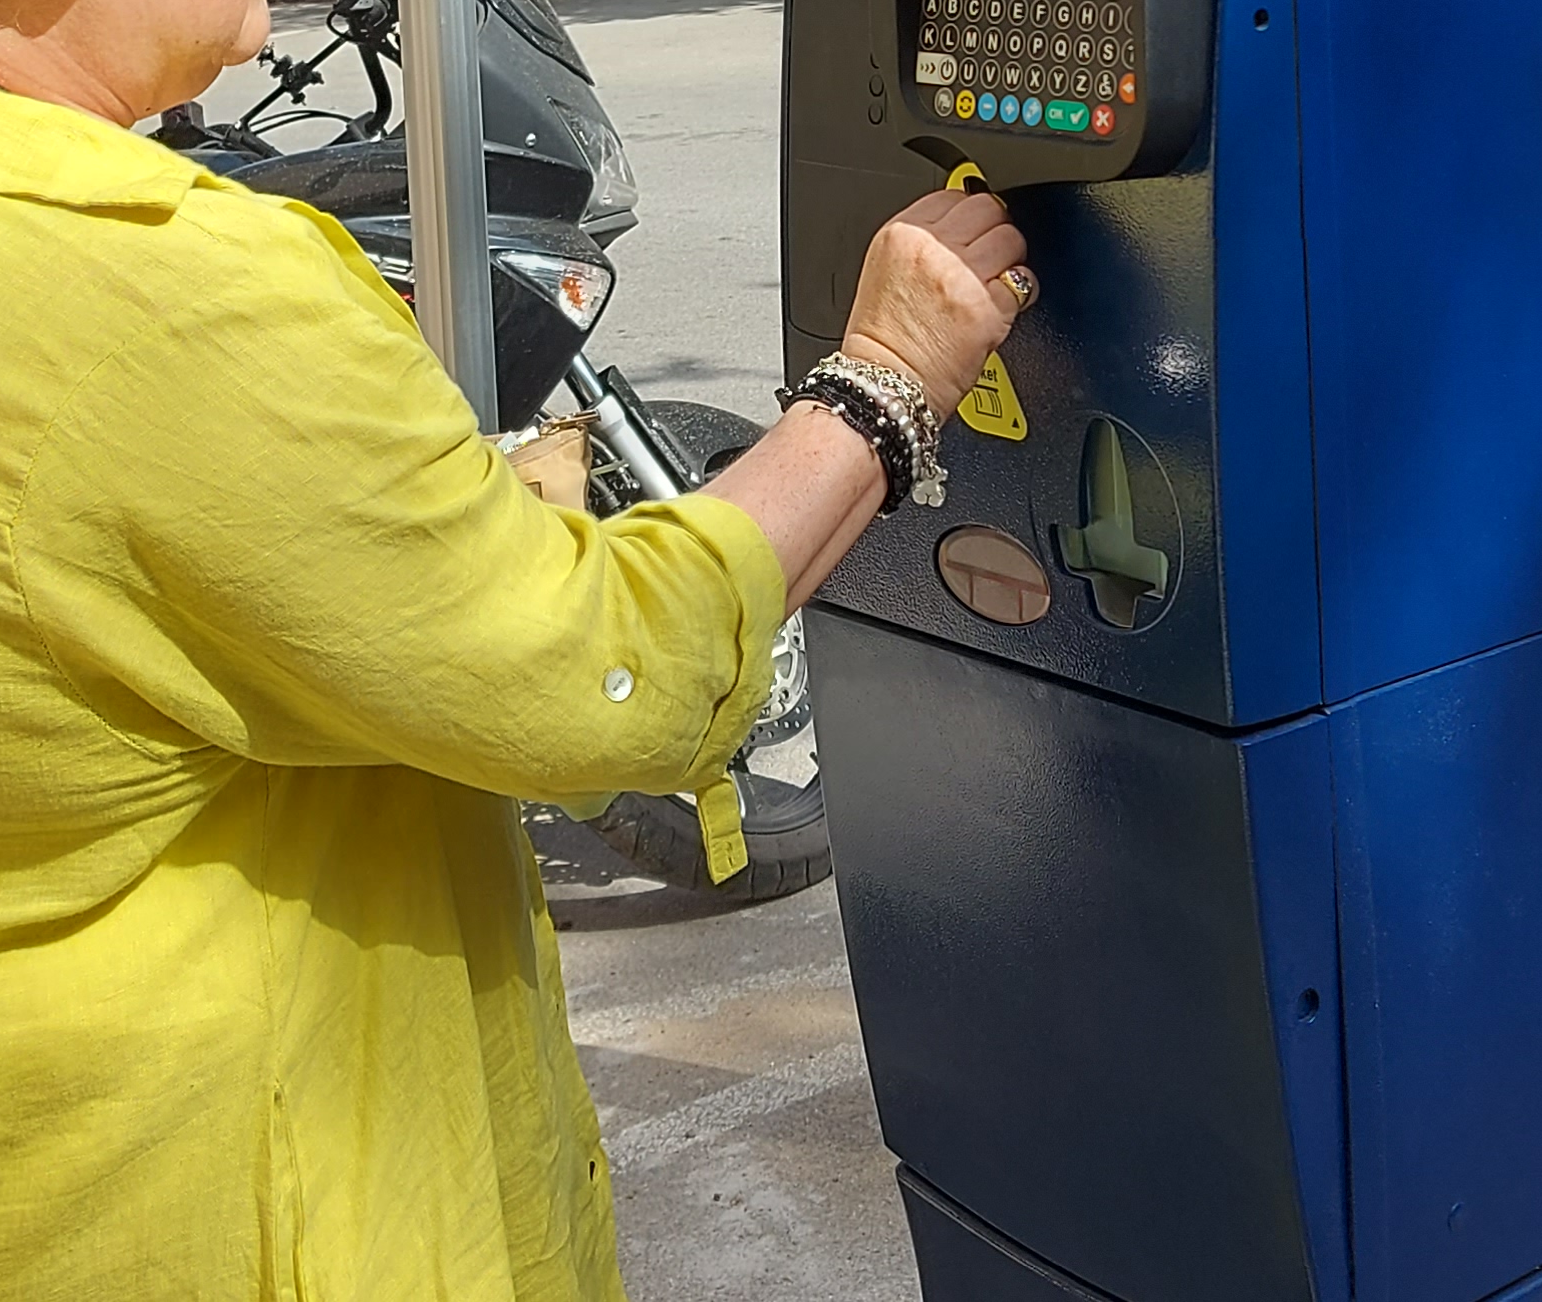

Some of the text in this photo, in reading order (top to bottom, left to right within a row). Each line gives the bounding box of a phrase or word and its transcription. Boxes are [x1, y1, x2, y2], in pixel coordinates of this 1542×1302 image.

[968, 0, 980, 16] C
[990, 1, 1001, 17] D
[1012, 2, 1024, 19] E
[1035, 4, 1046, 22] F
[1057, 5, 1070, 23] G
[1081, 7, 1093, 25] H
[924, 27, 935, 45] K
[945, 29, 955, 46] L
[965, 31, 978, 48] M
[987, 33, 999, 51] N
[1009, 35, 1021, 52] O
[1032, 37, 1043, 54] P
[1054, 39, 1067, 57] Q
[1078, 41, 1090, 59] R
[1102, 43, 1114, 61] S
[963, 63, 1088, 92] U V W X Y Z
[1048, 108, 1064, 120] OK
